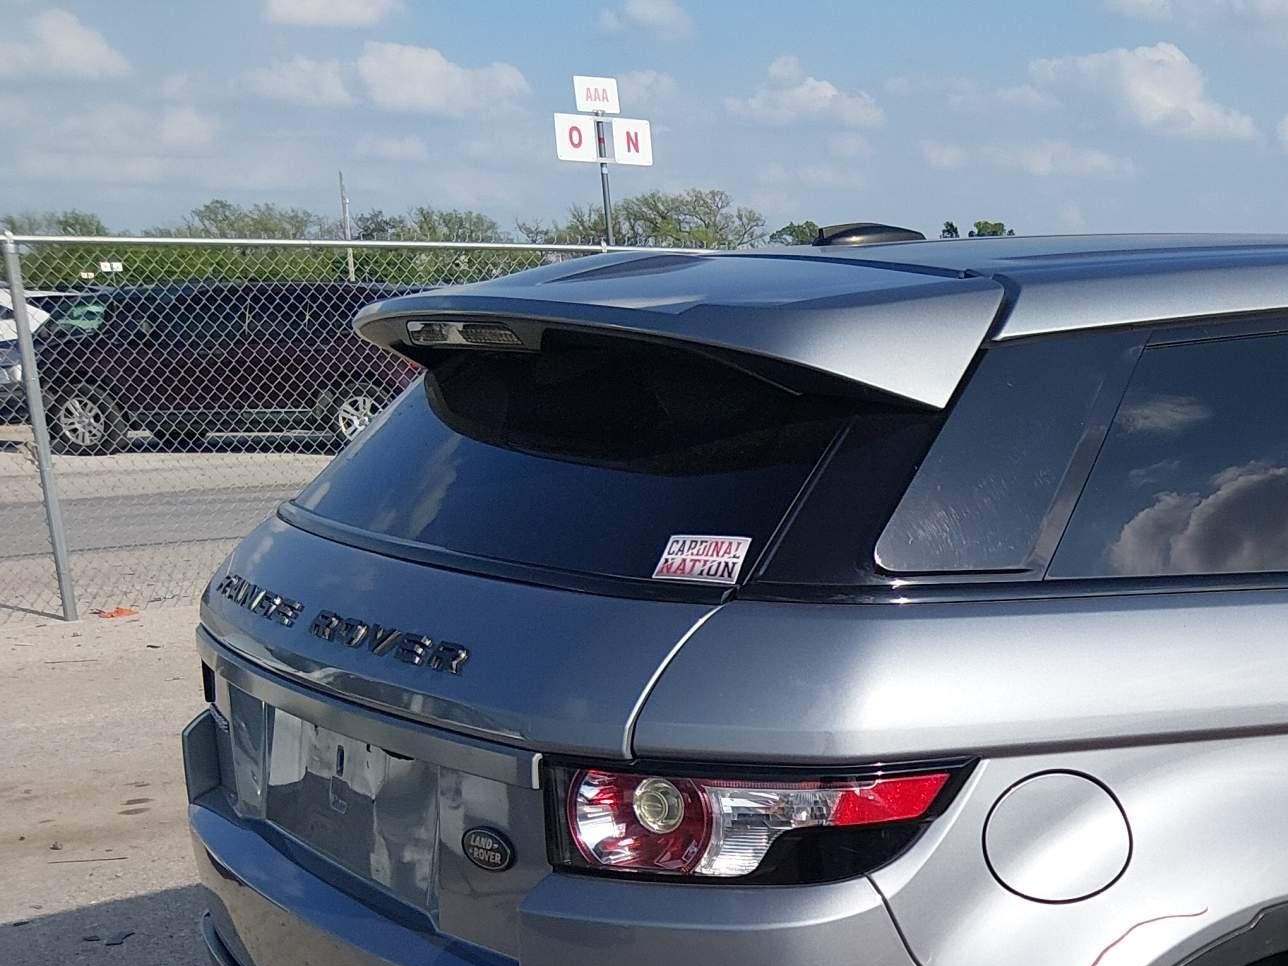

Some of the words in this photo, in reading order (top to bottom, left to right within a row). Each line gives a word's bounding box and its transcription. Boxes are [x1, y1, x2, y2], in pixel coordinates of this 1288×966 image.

[585, 87, 609, 103] AAA
[568, 125, 583, 149] O
[625, 130, 640, 153] N
[667, 539, 742, 559] CARDINAL
[660, 558, 737, 579] NATION
[216, 573, 305, 629] RANGE
[309, 608, 470, 678] ROVER
